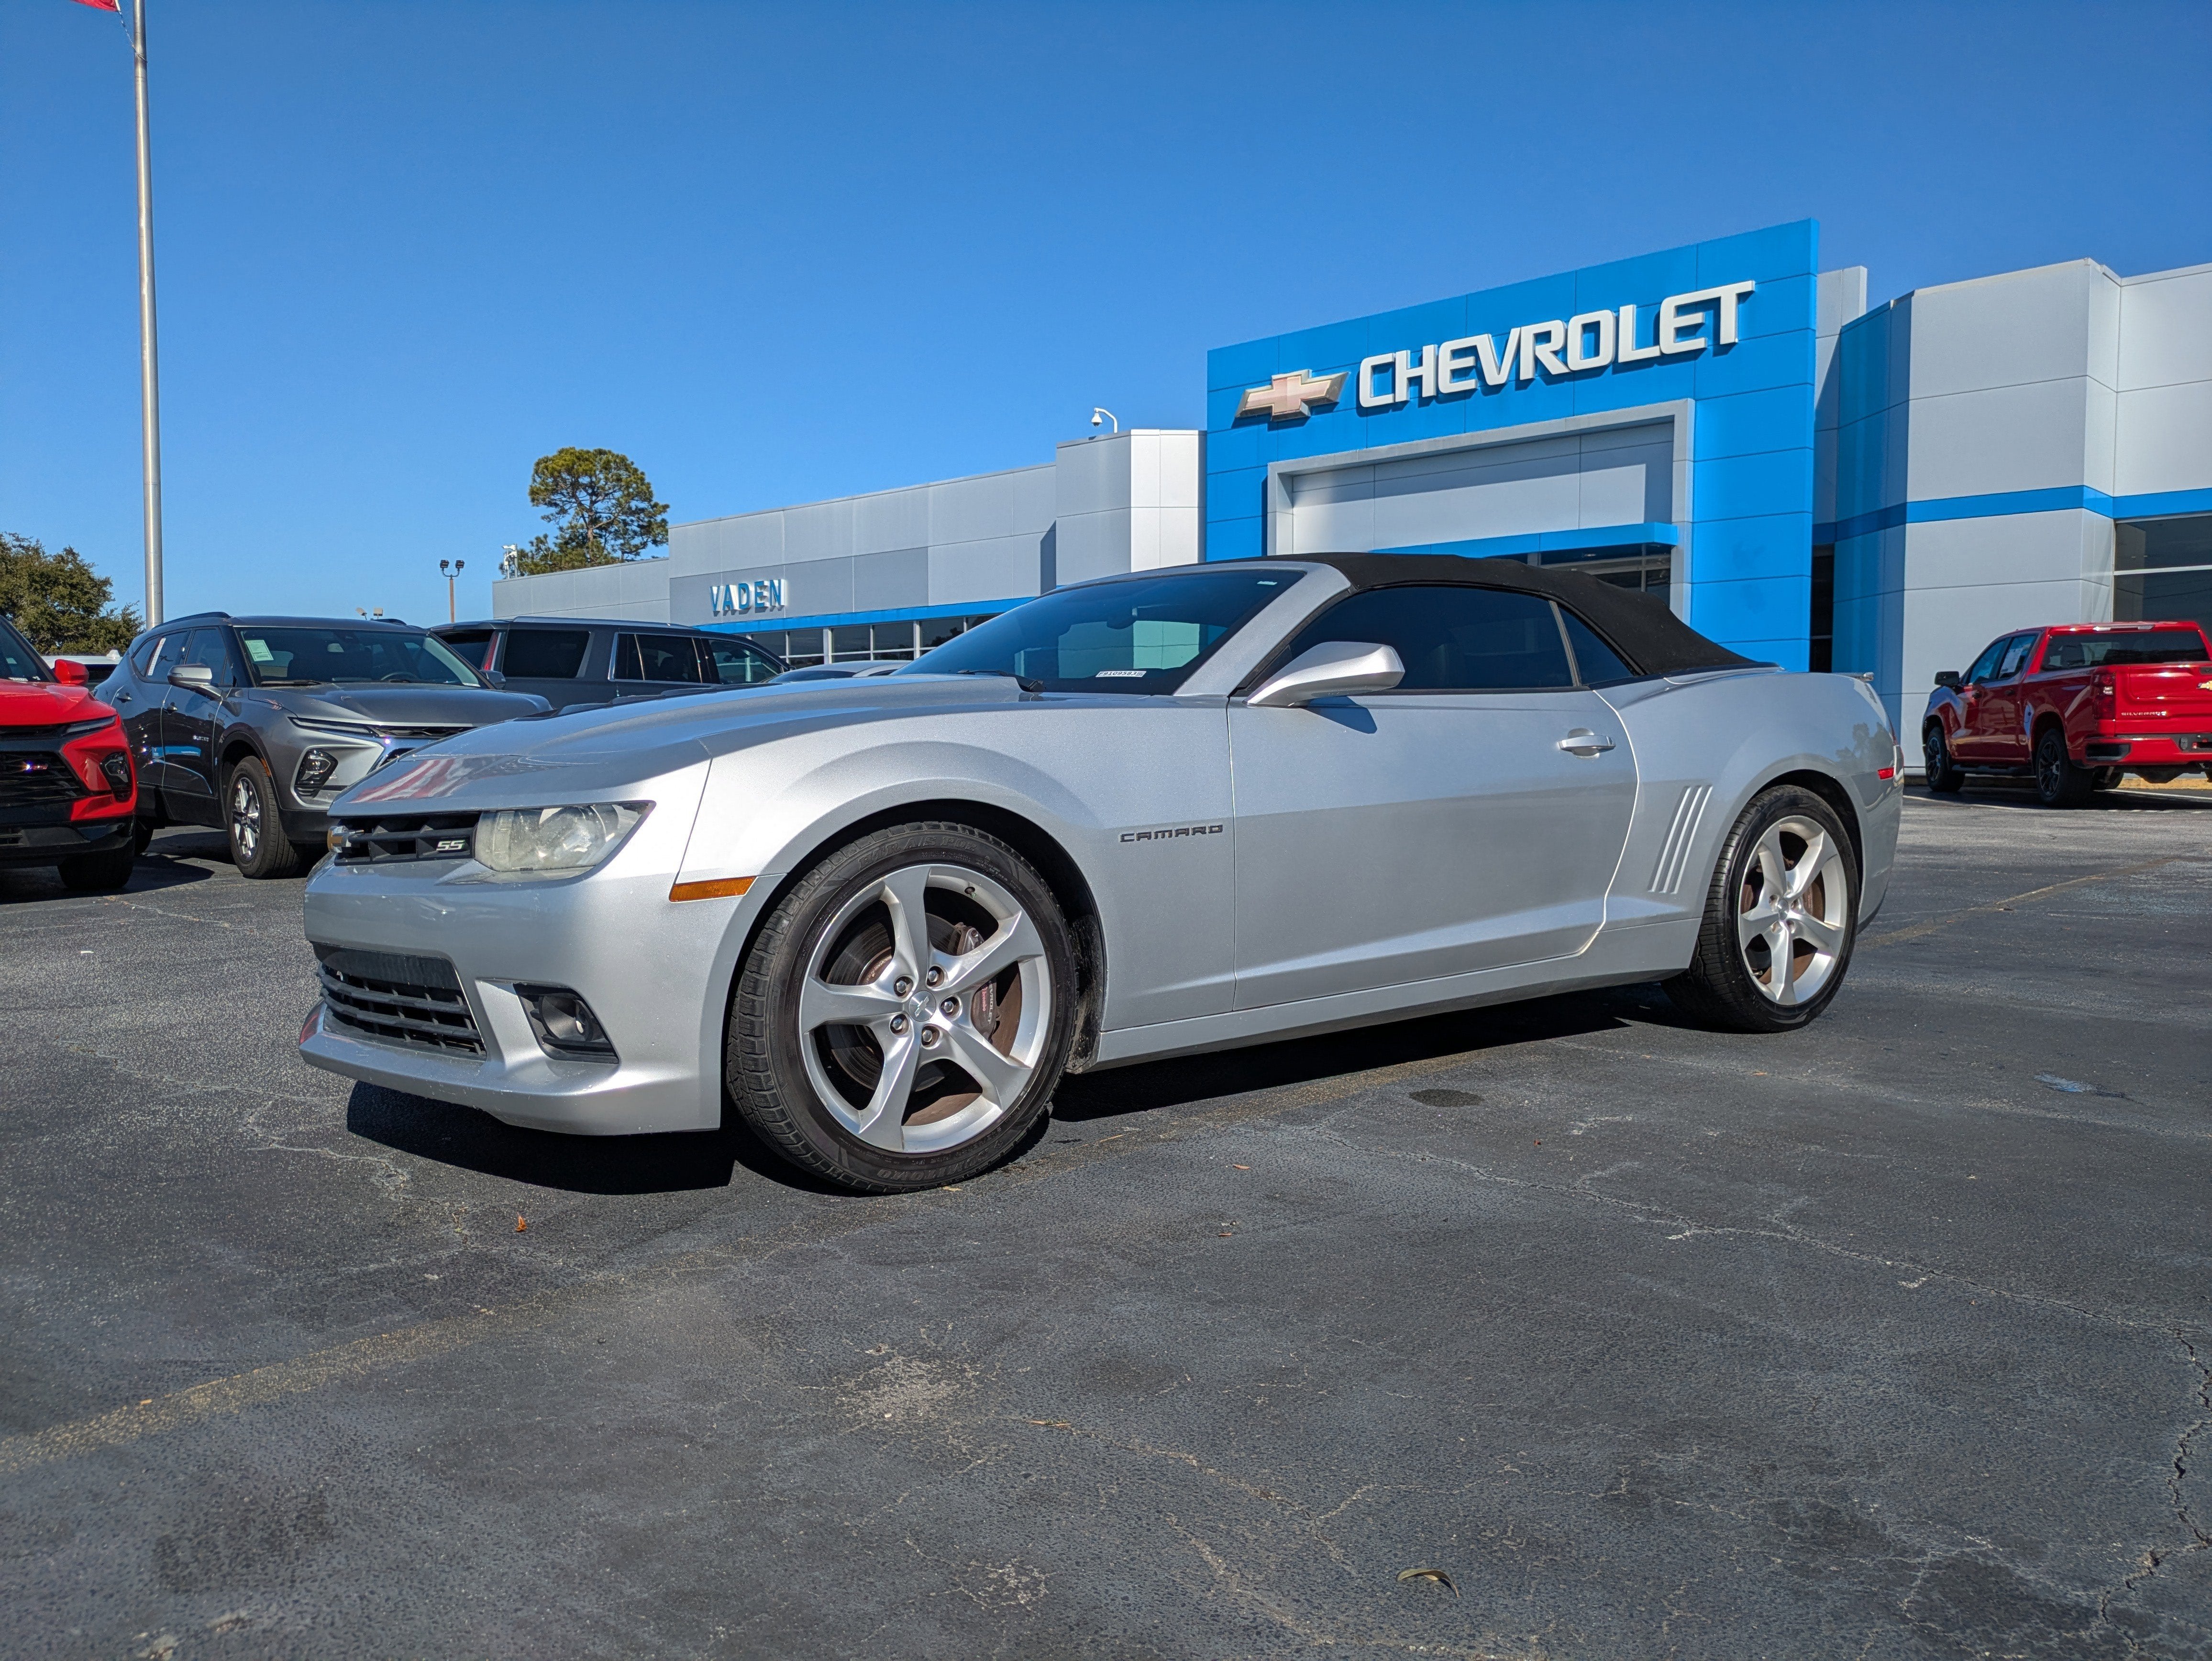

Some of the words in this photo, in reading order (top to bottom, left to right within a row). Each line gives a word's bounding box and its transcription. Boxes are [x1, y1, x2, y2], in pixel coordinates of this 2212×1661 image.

[1359, 280, 1755, 408] CHEVROLET
[709, 579, 784, 611] VADEN
[436, 840, 465, 851] SS
[1119, 824, 1223, 842] CAMARO
[859, 842, 901, 870] HTR
[904, 836, 937, 850] A/S
[877, 1148, 989, 1181] SUMITOMO
